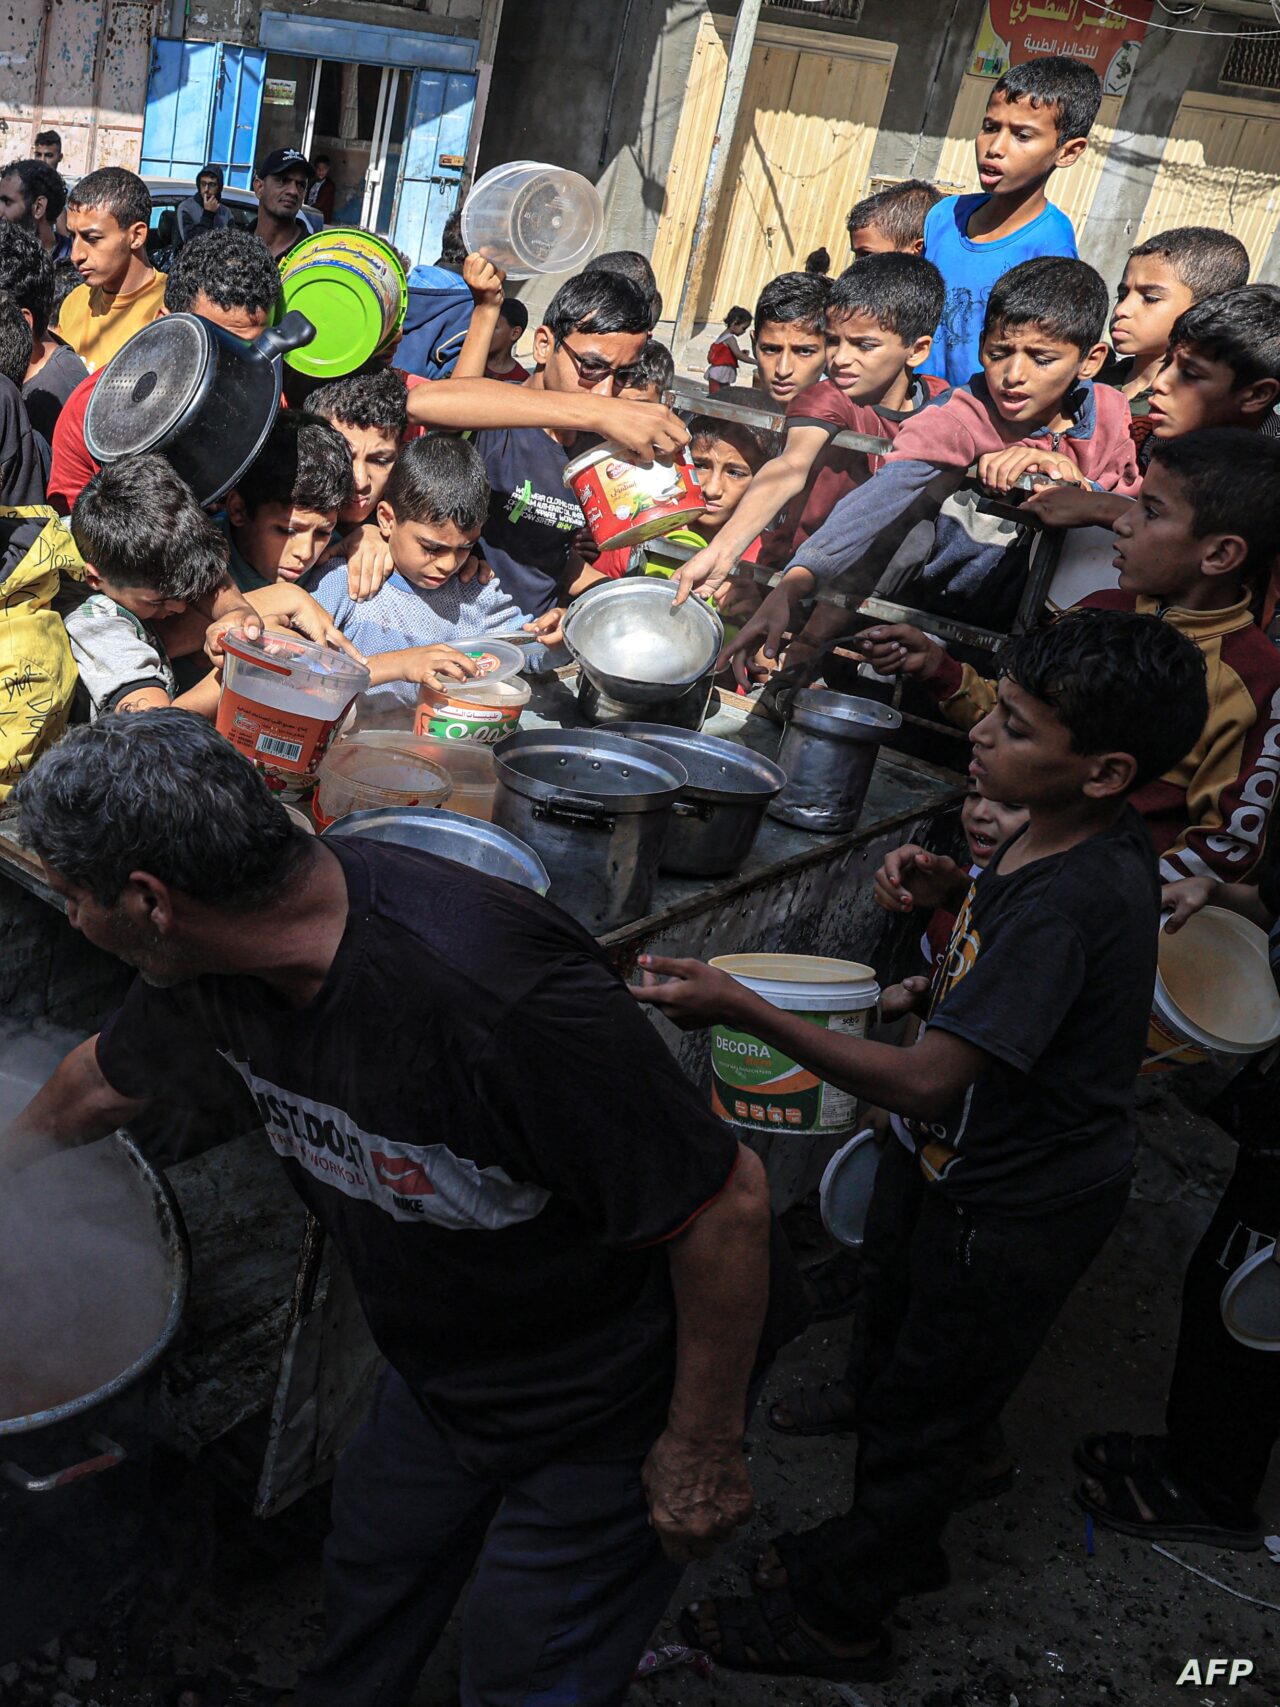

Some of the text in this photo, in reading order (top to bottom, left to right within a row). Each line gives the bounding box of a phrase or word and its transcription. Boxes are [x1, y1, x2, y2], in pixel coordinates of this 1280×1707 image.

[1023, 33, 1100, 60] للتحاليل الطبية
[1206, 686, 1280, 862] idas
[716, 1035, 771, 1058] DECORA
[256, 1092, 308, 1141] UST.
[393, 1194, 424, 1214] NIKE
